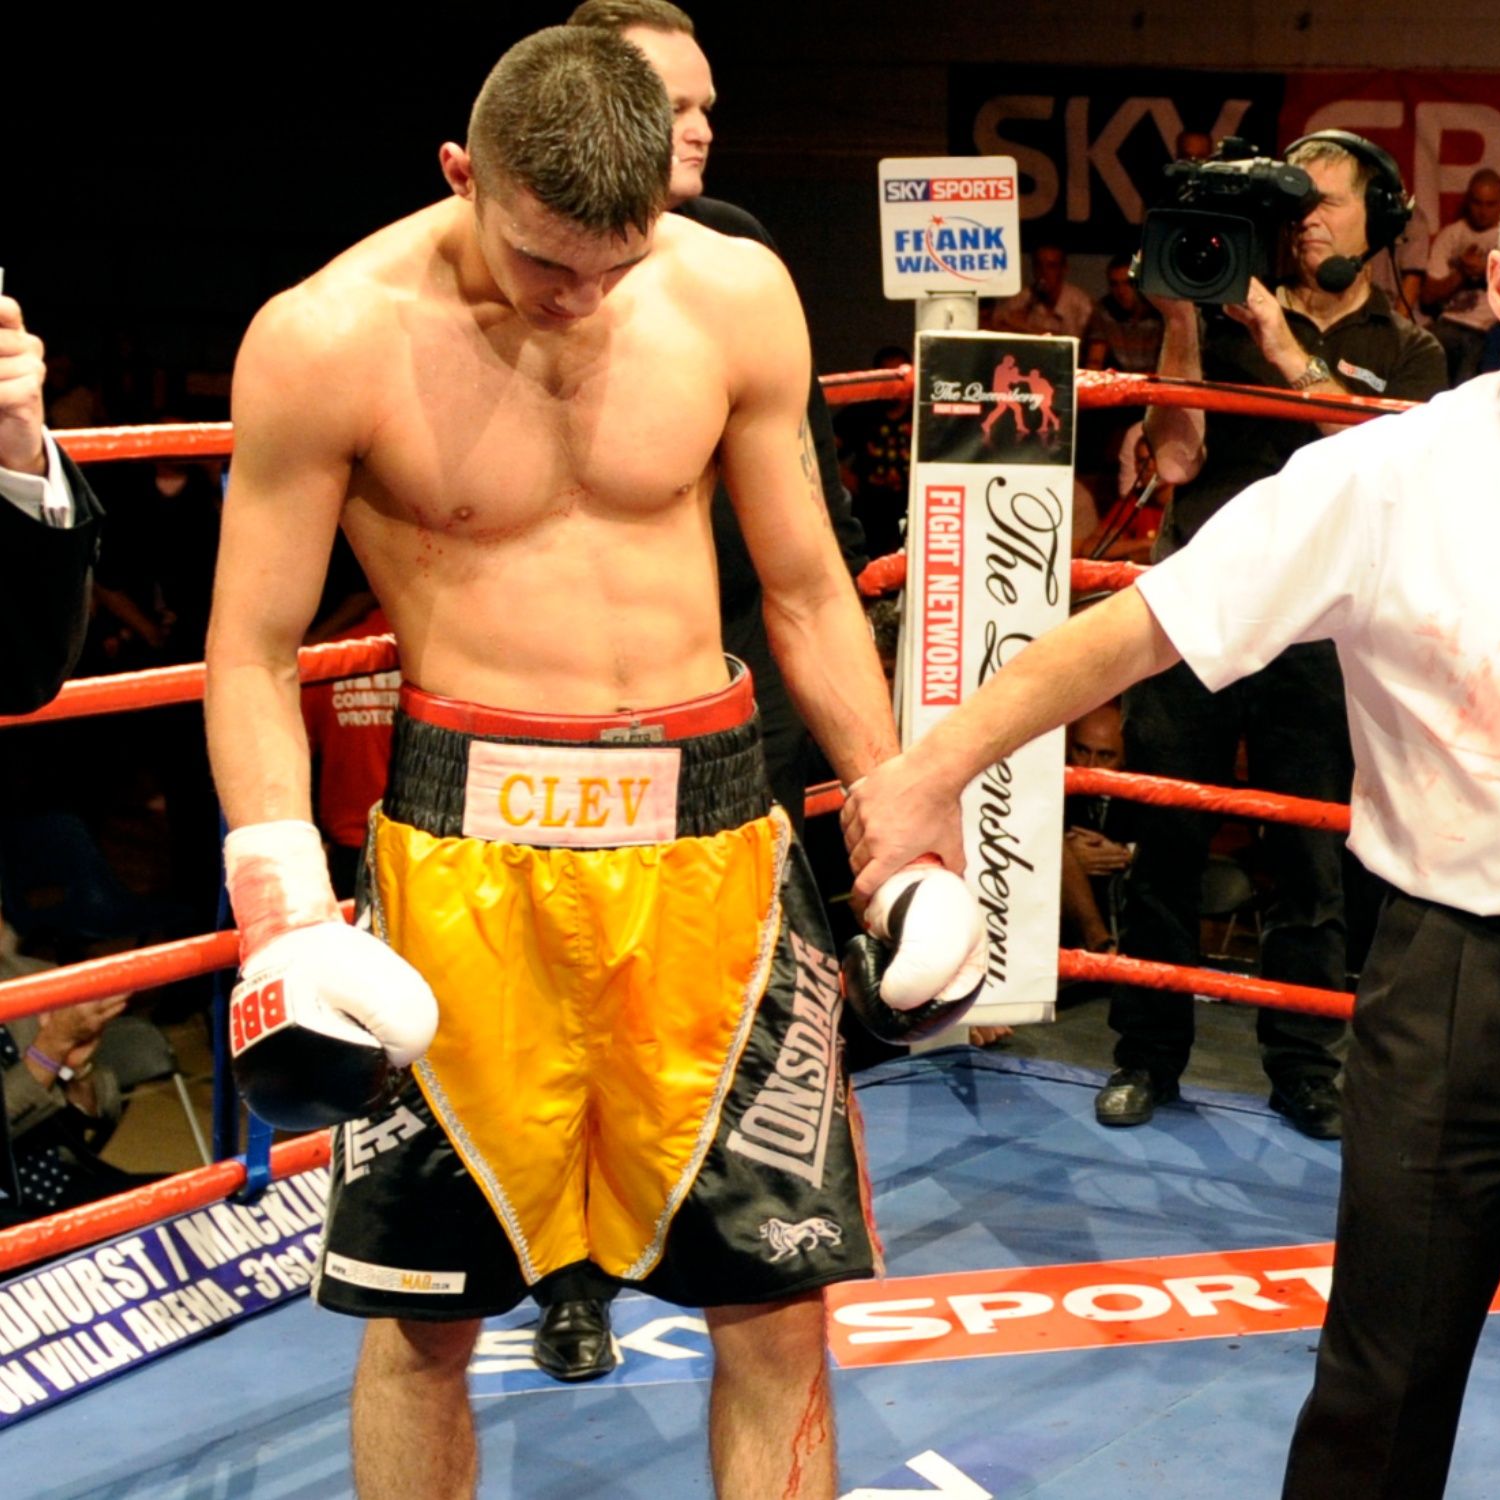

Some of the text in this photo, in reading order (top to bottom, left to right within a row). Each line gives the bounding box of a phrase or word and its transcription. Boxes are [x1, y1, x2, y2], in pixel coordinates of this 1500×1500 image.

[886, 179, 1012, 201] SKY SPORTS
[894, 226, 1004, 253] FRANK
[895, 253, 1008, 274] WARREN
[930, 379, 962, 402] The
[985, 476, 1063, 606] The
[925, 489, 962, 700] FIGHT NETWORK
[498, 773, 651, 828] CLEV
[726, 930, 842, 1189] LONSDALE
[24, 1321, 145, 1392] VILLA
[120, 1277, 244, 1353] ARENA
